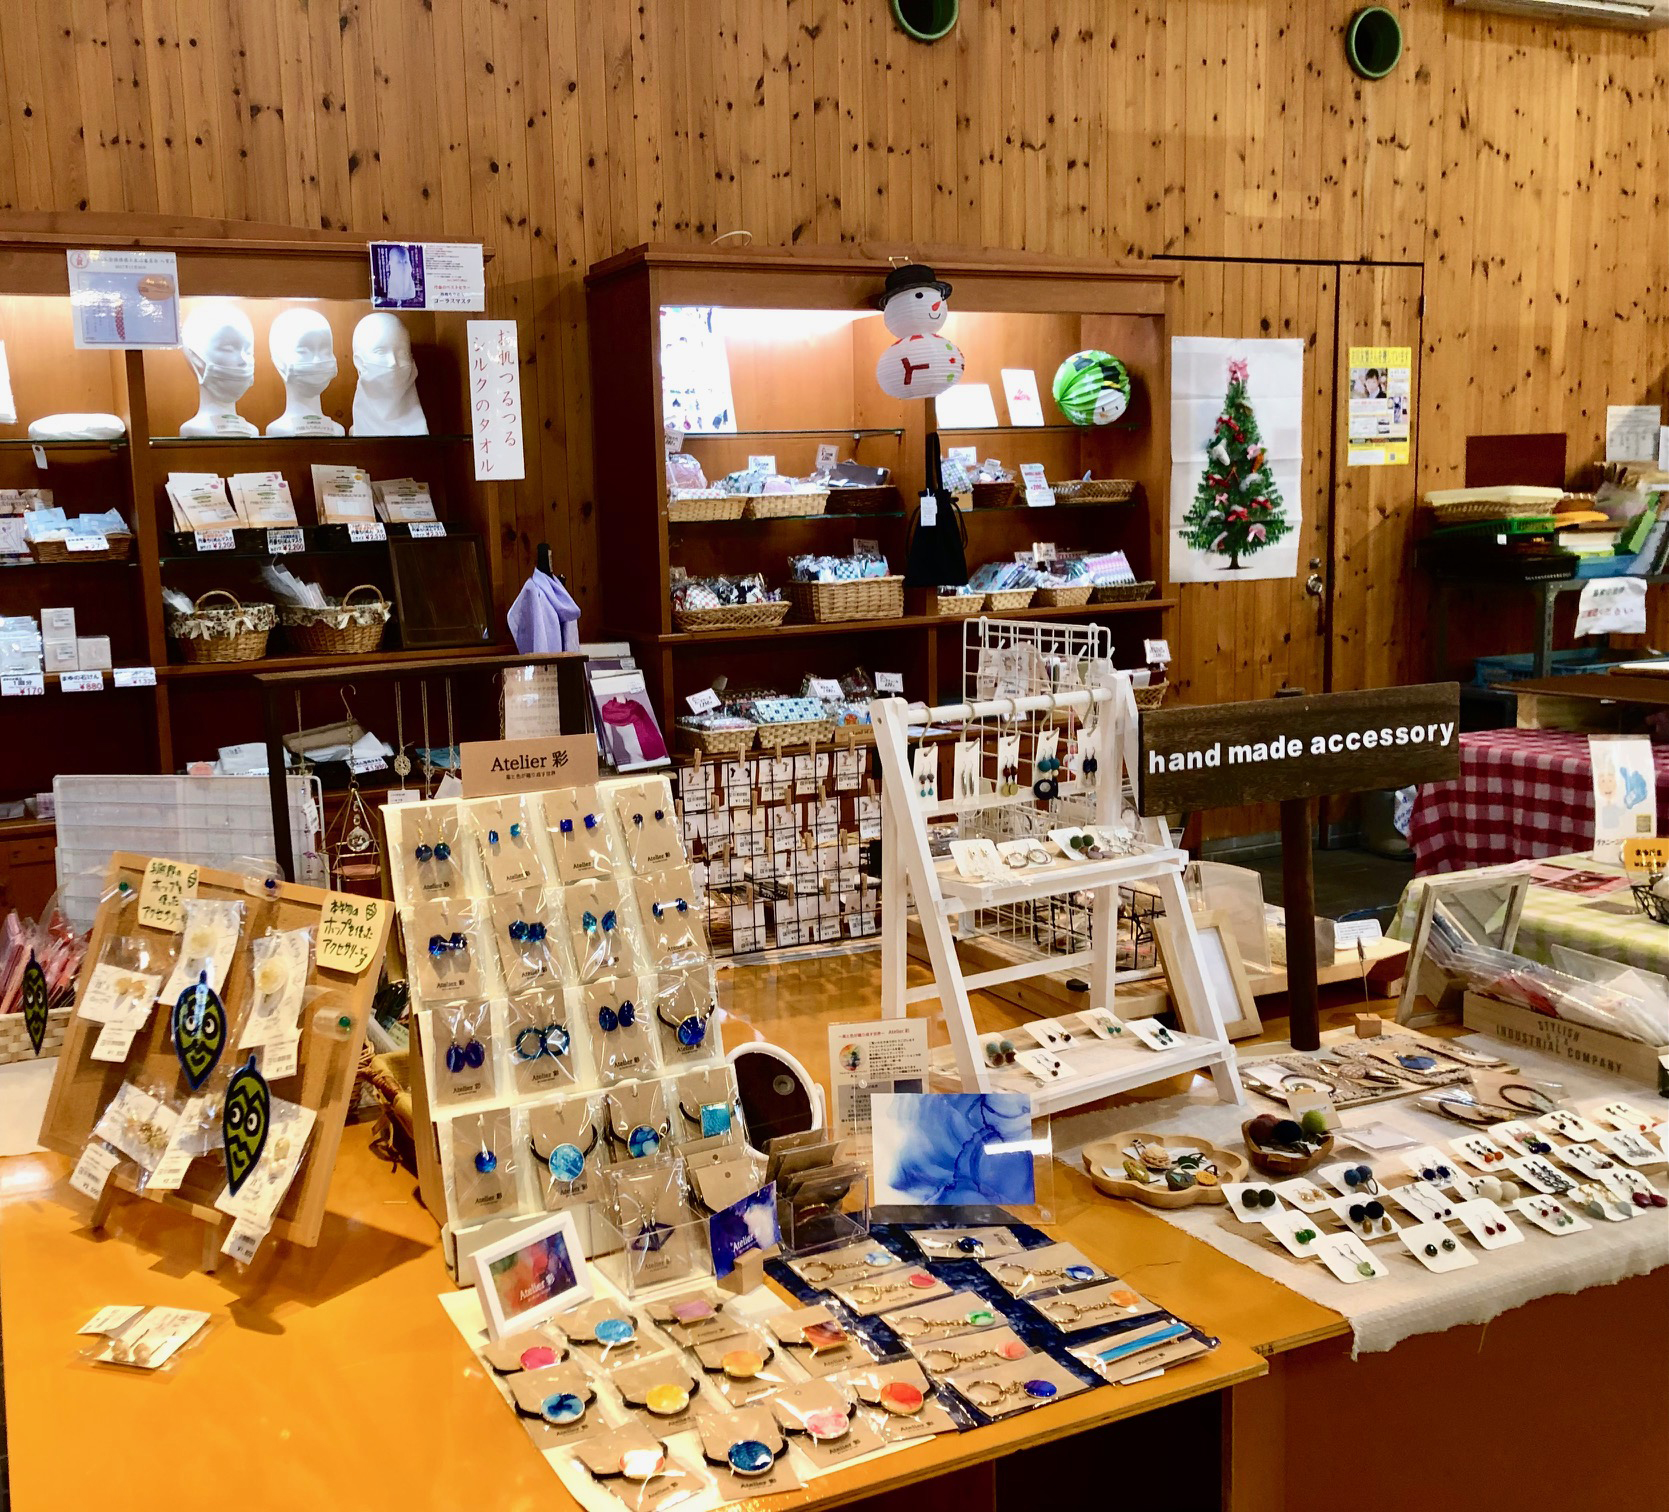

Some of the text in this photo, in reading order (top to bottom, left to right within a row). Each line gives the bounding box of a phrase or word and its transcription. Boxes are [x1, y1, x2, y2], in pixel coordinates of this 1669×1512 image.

[1149, 722, 1455, 774] hand made accessory
[490, 750, 568, 772] Atelier 彩
[324, 916, 374, 940] ホップを使った
[1537, 1020, 1580, 1042] STYLISH
[1496, 1024, 1561, 1054] INDUSTRIAL
[1567, 1047, 1623, 1074] COMPANY
[532, 1072, 552, 1082] Atelier
[453, 1084, 473, 1094] Atelier
